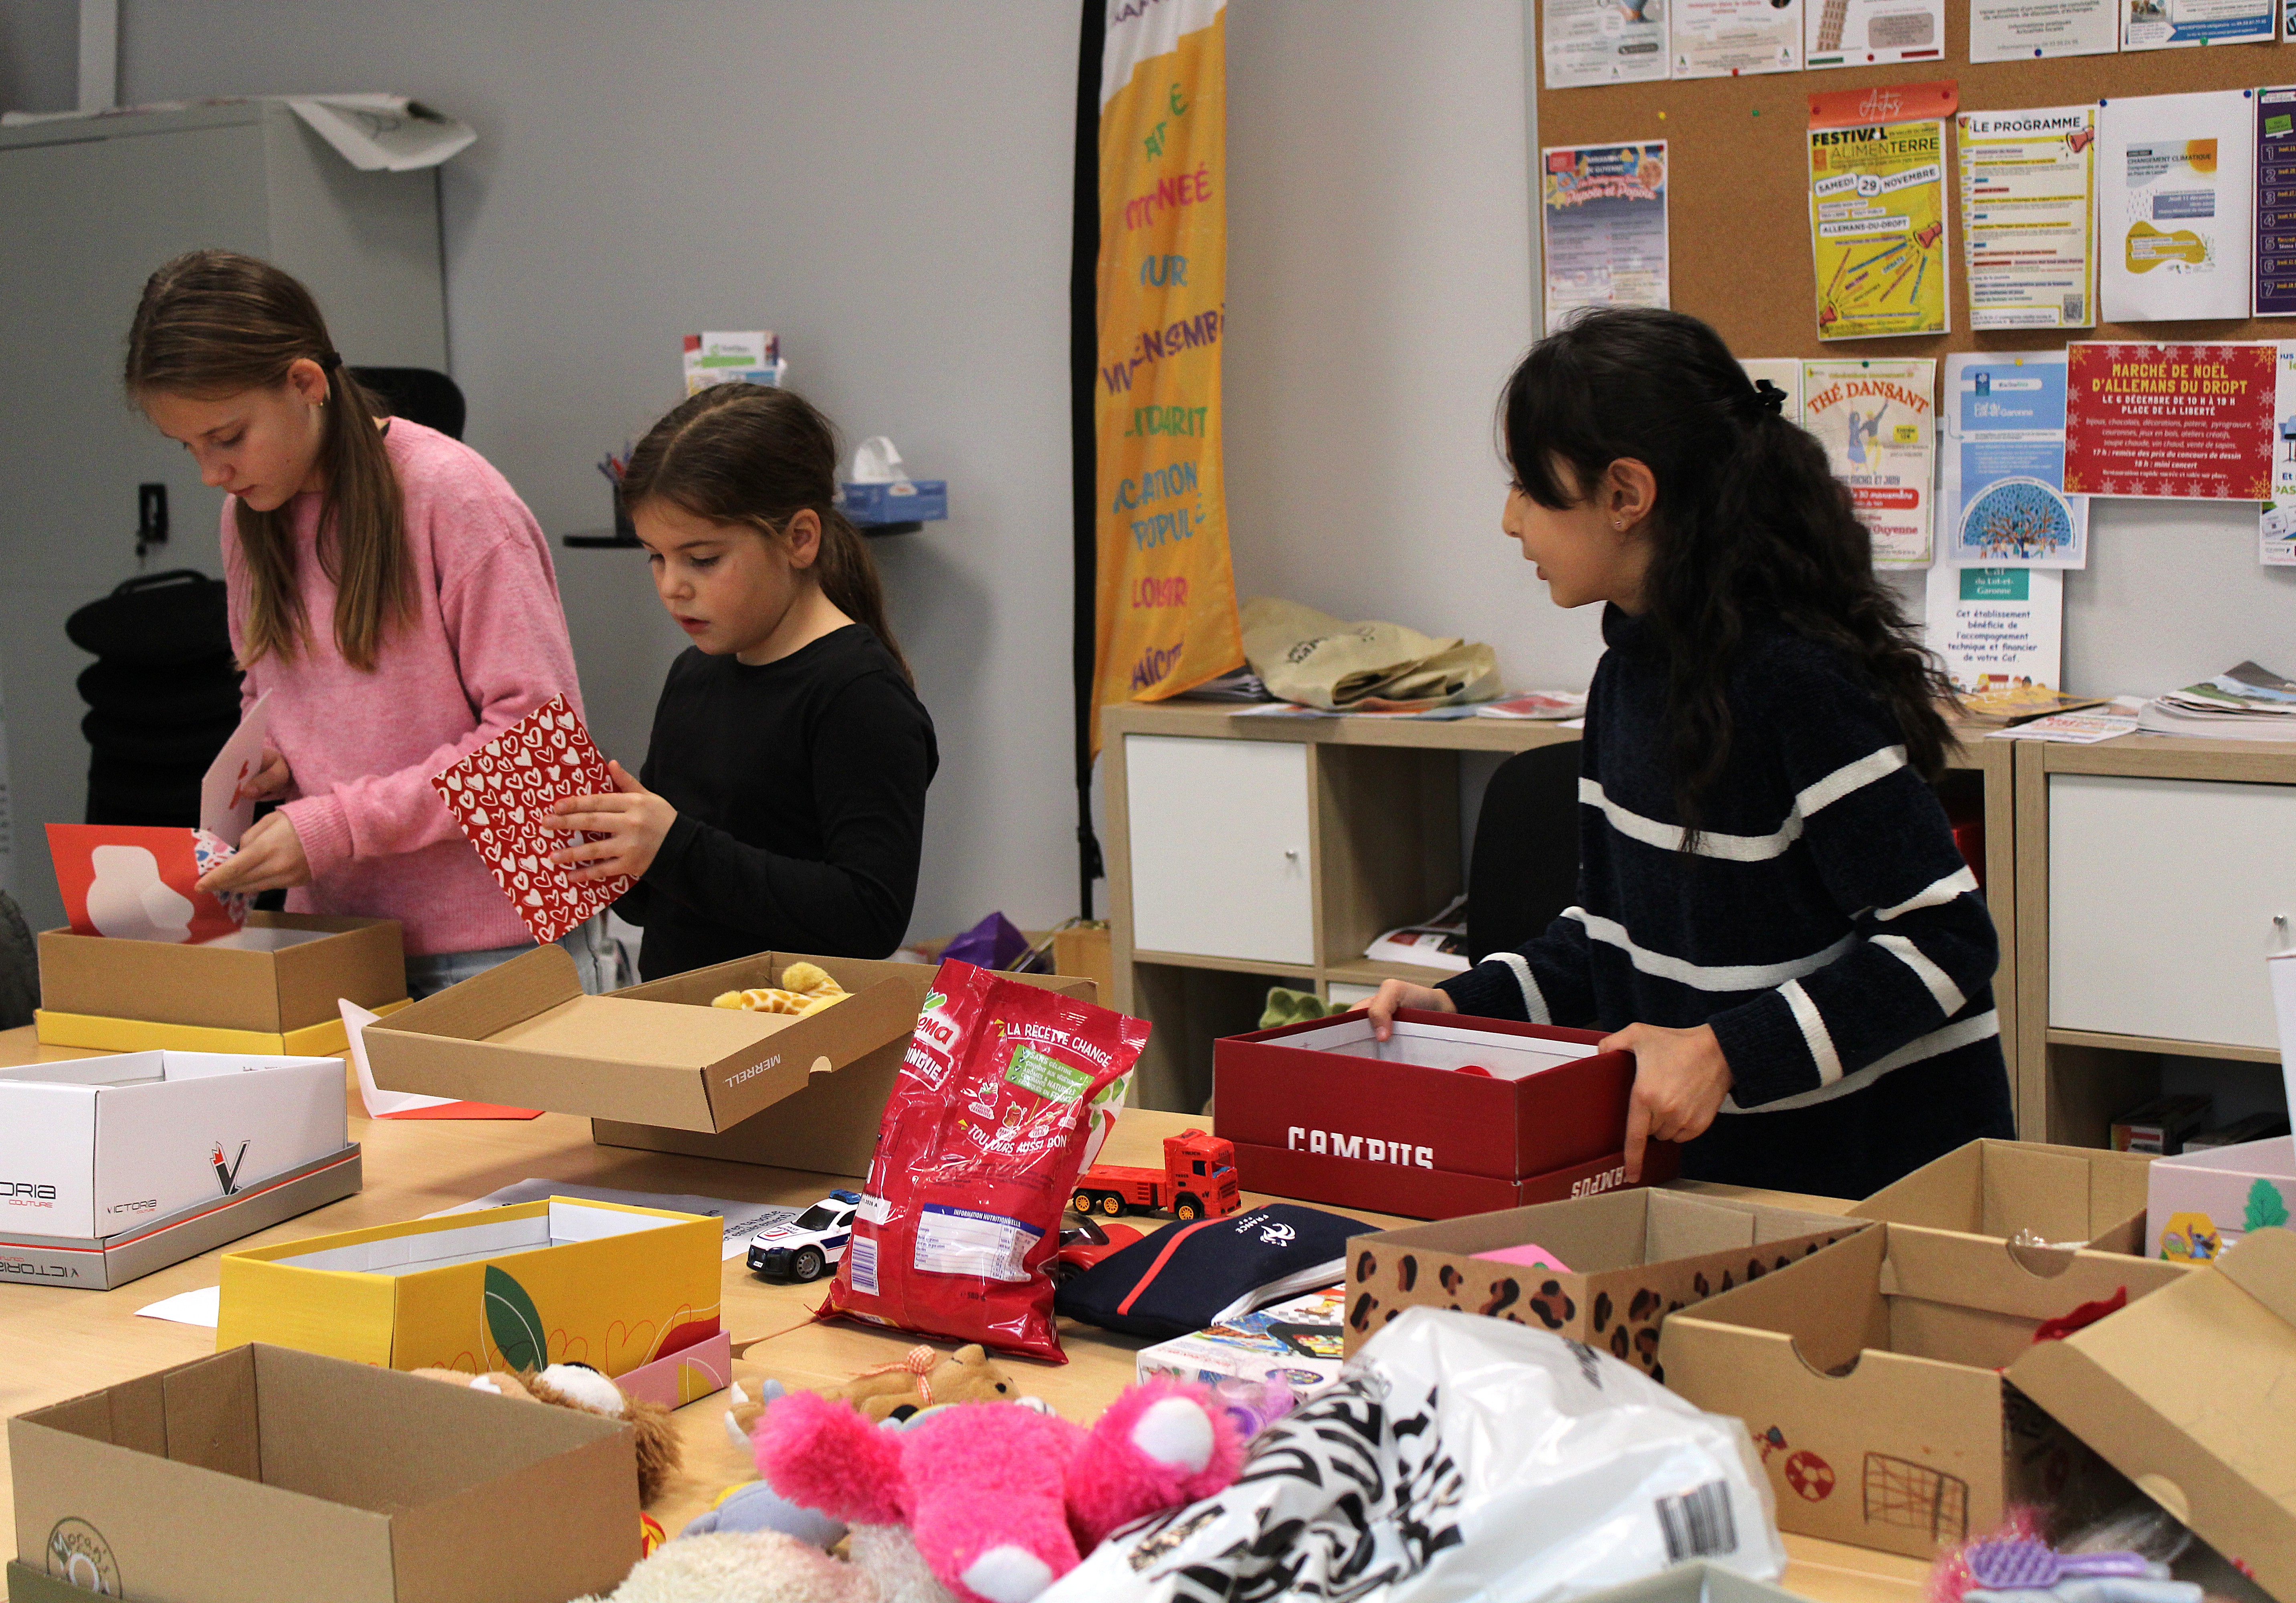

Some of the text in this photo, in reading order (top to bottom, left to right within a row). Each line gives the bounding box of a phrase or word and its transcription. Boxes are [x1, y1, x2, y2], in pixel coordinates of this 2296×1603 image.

[1974, 117, 2080, 132] LE PROGRAMME
[1813, 127, 1888, 146] FESTIVAL
[1831, 137, 1939, 158] ALIMENTERRE
[2266, 146, 2274, 160] 1
[1819, 168, 1935, 192] SAMEDI 29 NOVEMBRE
[2265, 169, 2276, 182] 2
[2264, 214, 2276, 227] 4
[2264, 260, 2274, 272] 6
[2264, 281, 2274, 297] 7
[2112, 361, 2228, 379] MARCHÉ DE NOËL
[2092, 378, 2248, 394] D'ALLEMANS DU DROPT
[1807, 381, 1929, 414] THÉ DANSANT
[2102, 394, 2113, 404] LE
[2125, 394, 2170, 405] DÉCEMBRE
[2173, 396, 2184, 405] DE
[2122, 405, 2215, 416] PLACE DE LA LIBERTÉ
[1956, 610, 2030, 618] Cet établissement
[1968, 621, 2004, 629] bénéficie
[1957, 632, 2029, 642] l'accompagnement
[1948, 643, 1986, 652] technique
[2003, 643, 2038, 651] financier
[1007, 1023, 1021, 1035] LA
[1072, 1037, 1112, 1068] CHANGE
[725, 1054, 781, 1088] MERRELL
[1030, 1051, 1072, 1076] SANS GÉLATINE
[971, 1106, 992, 1118] FRAMBOISE
[1016, 1139, 1044, 1154] AUSSI
[1047, 1135, 1067, 1148] BON
[1288, 1126, 1433, 1170] CAMPUS
[9, 1199, 53, 1208] COUTURE
[953, 1209, 1021, 1227] INFORMATION NUTRITIONNELLE
[1235, 1213, 1270, 1235] FRANCE
